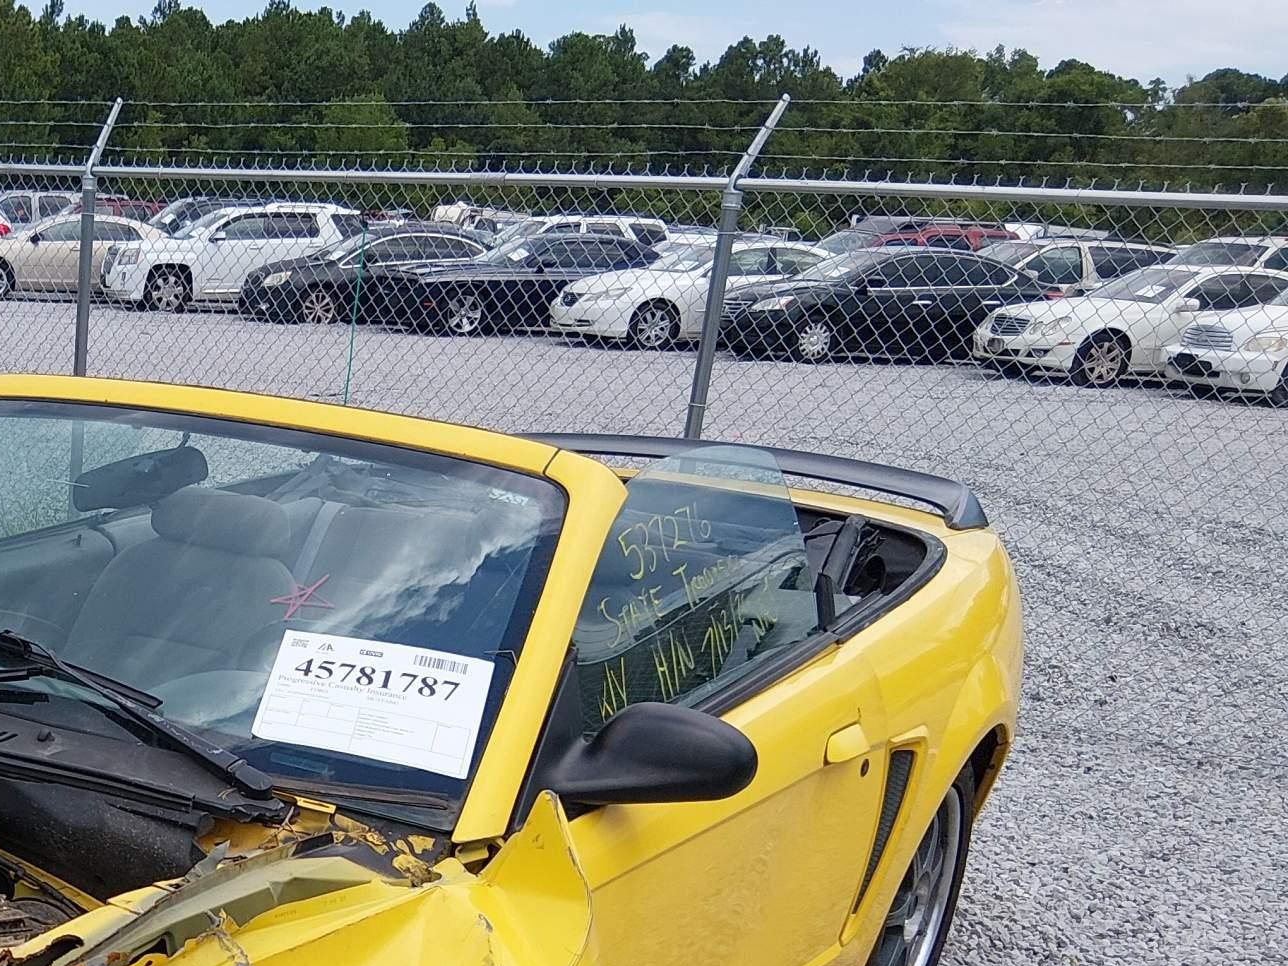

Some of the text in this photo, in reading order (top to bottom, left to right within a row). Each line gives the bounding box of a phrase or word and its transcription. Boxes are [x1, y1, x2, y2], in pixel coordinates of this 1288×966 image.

[618, 501, 712, 580] 537276
[598, 584, 664, 649] STATE
[278, 674, 326, 688] Progressive
[294, 657, 461, 702] 45781787
